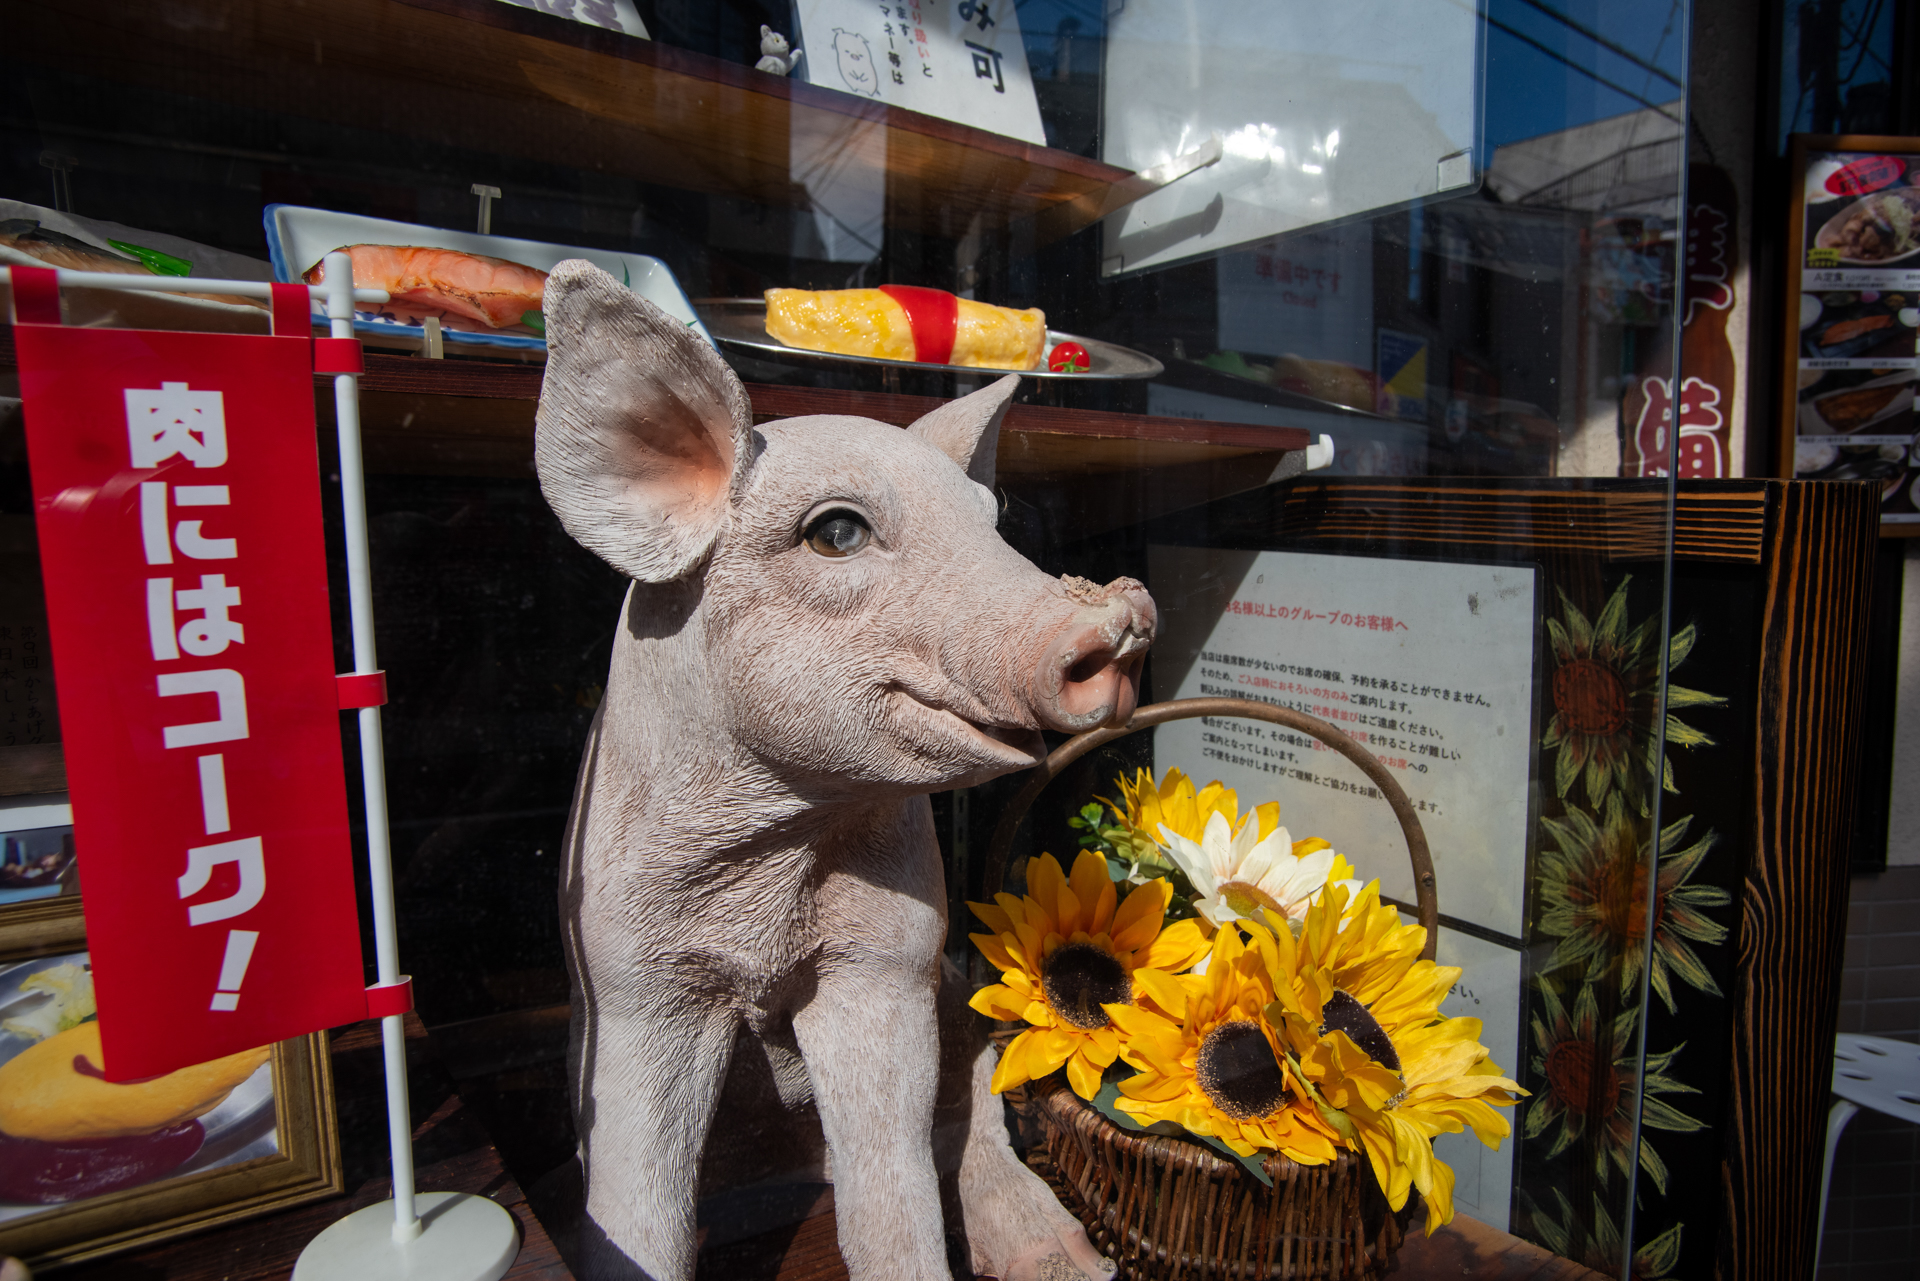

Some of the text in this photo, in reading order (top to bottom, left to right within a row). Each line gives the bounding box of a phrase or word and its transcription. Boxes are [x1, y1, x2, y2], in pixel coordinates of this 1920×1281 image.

[879, 0, 904, 86] マネー等は
[895, 0, 914, 45] ます。
